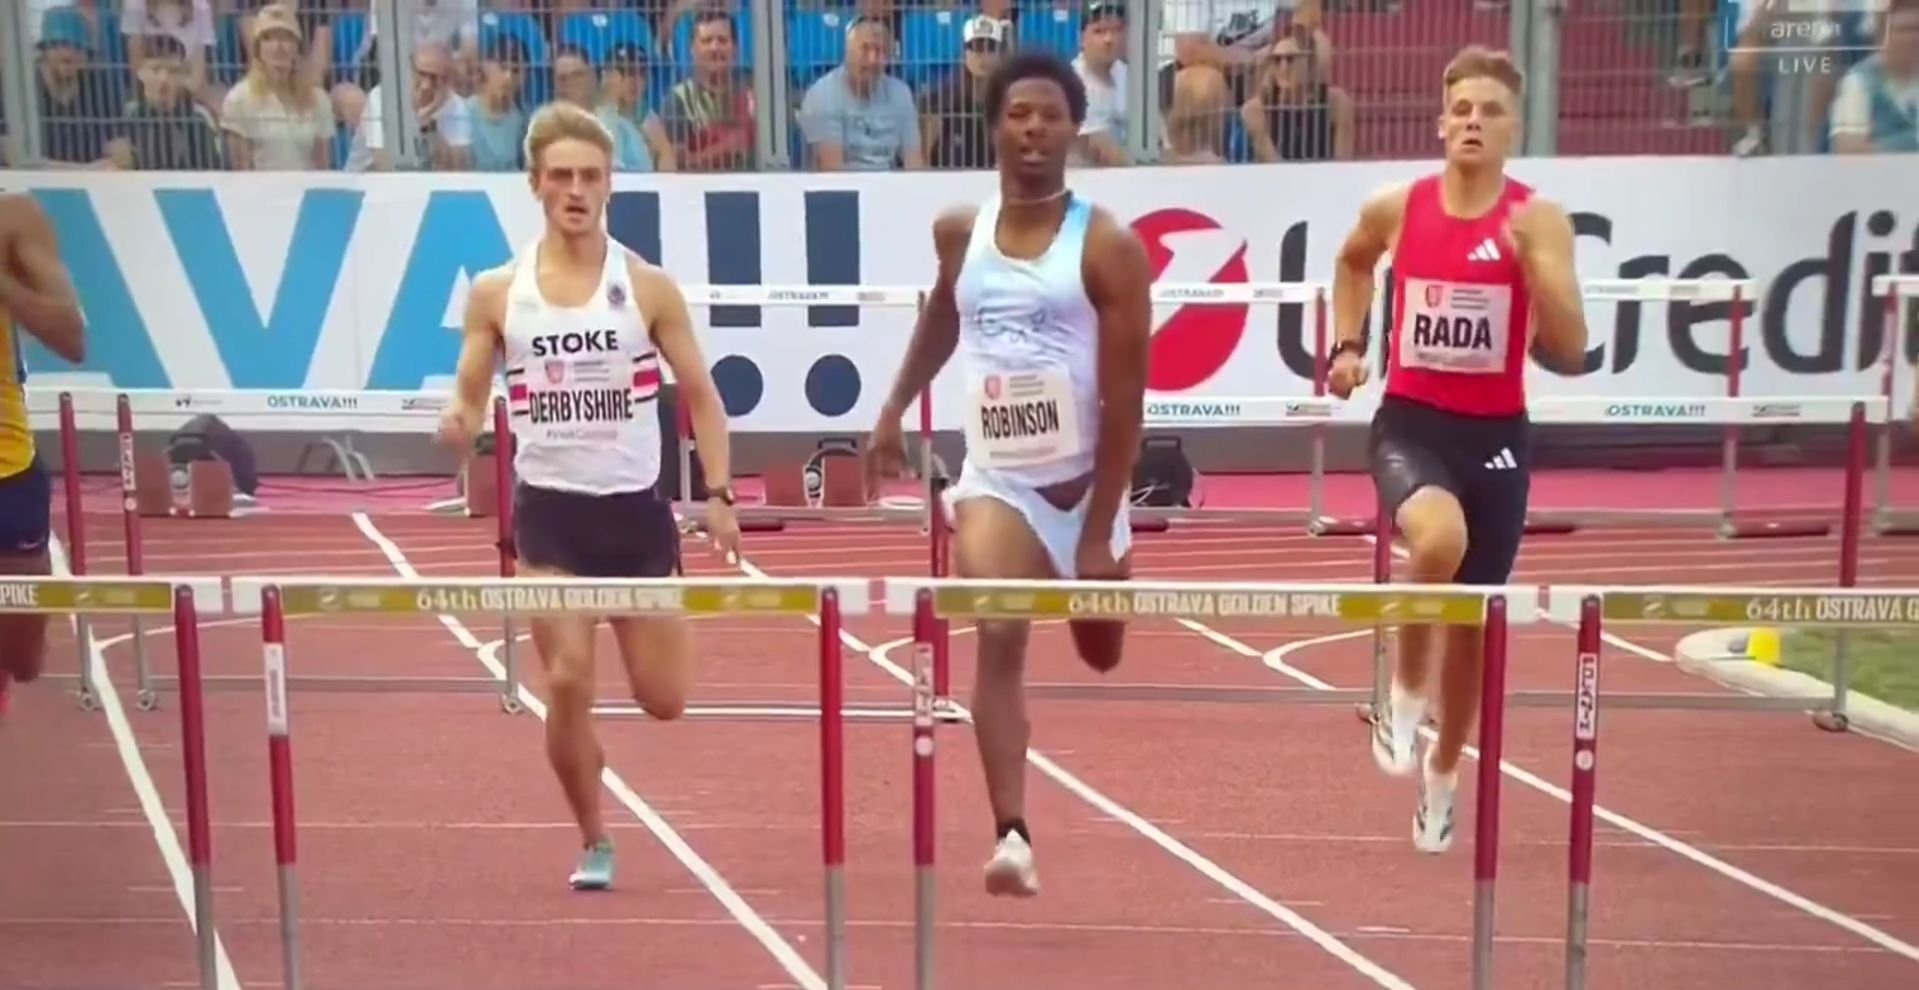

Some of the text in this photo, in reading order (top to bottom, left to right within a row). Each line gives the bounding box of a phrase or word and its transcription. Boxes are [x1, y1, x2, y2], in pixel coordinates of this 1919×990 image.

[531, 330, 620, 357] STOKE
[1414, 313, 1493, 351] RADA
[266, 395, 358, 410] OSTRAVA!!!
[529, 388, 634, 424] DERBYSHIRE
[1147, 404, 1241, 416] OSTRAVA!!!
[1605, 404, 1707, 417] OSTRAVA!!!
[981, 400, 1060, 440] ROBINSON
[416, 587, 478, 610] 64th
[480, 587, 563, 610] OSTRAVA
[1133, 591, 1214, 615] OSTRAVA
[1217, 592, 1287, 616] GOLDEN
[1290, 593, 1342, 617] SPIKE
[1746, 597, 1811, 620] 64th
[1815, 596, 1903, 621] OSTRAVA
